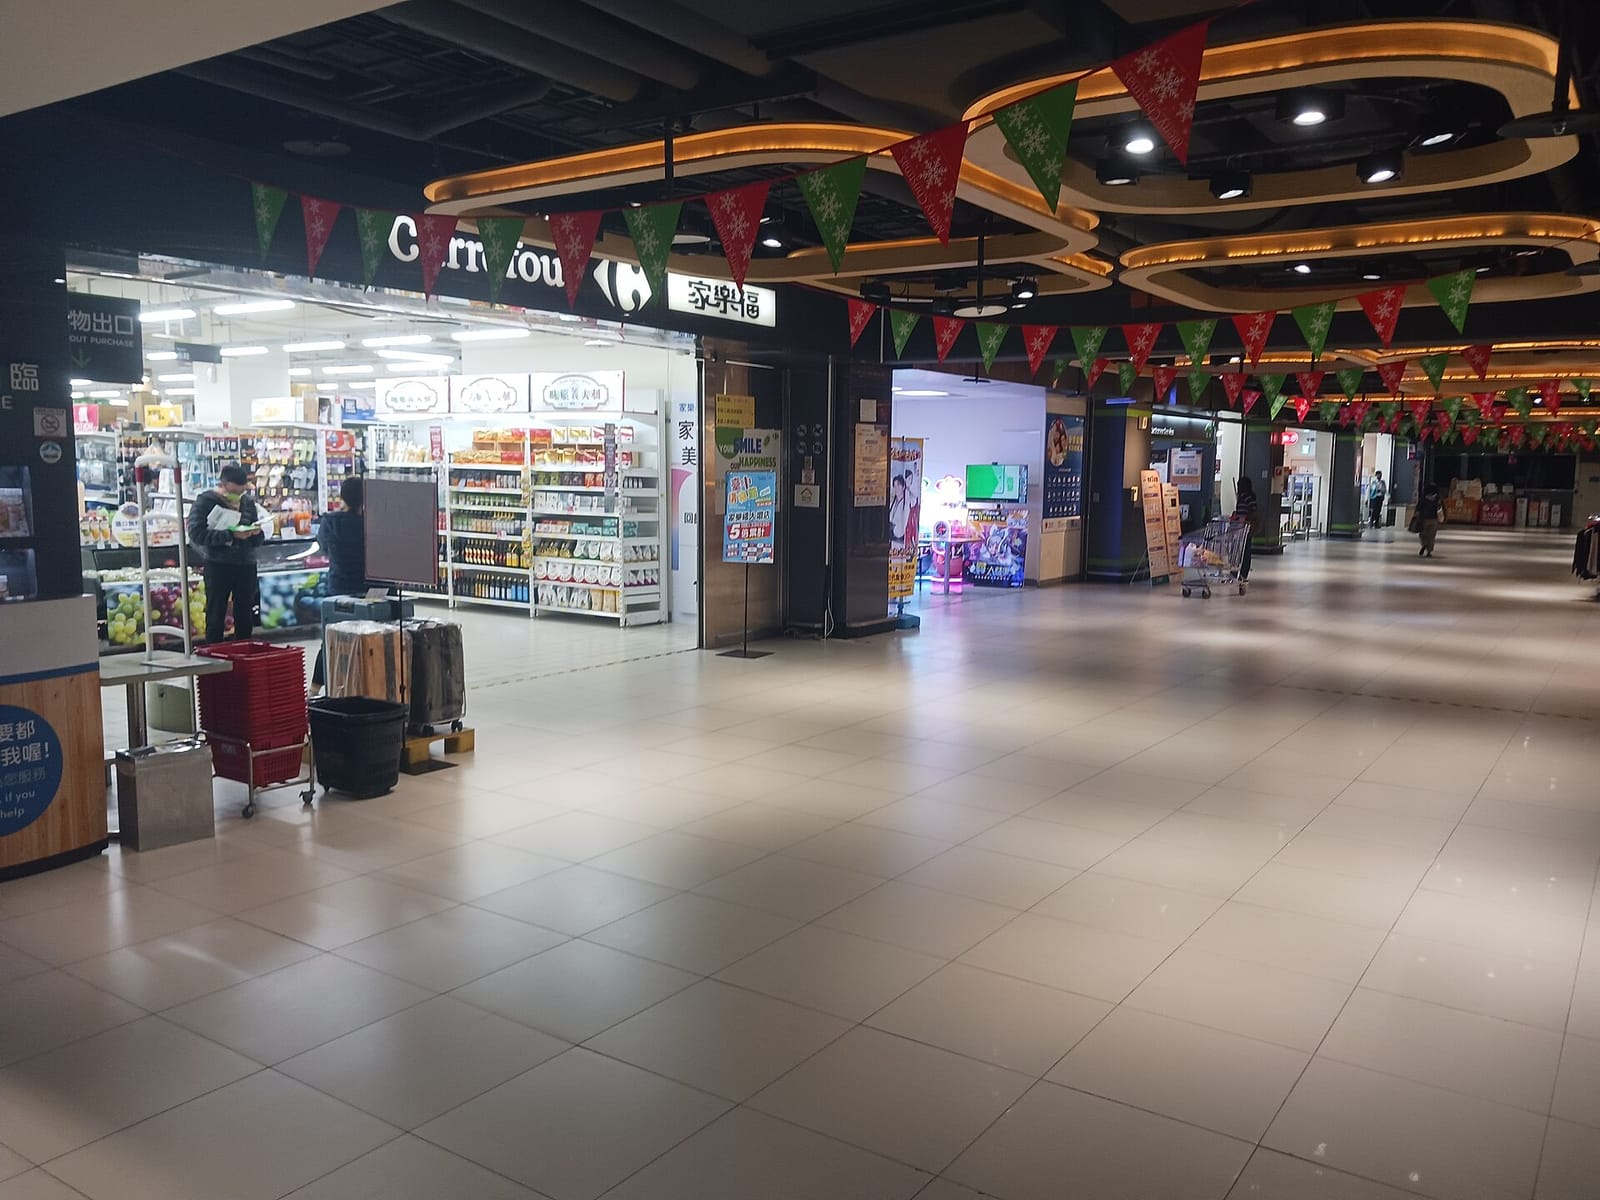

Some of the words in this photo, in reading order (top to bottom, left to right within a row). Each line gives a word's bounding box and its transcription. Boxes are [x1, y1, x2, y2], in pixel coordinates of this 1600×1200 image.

[688, 280, 760, 320] 家樂福
[90, 337, 134, 348] PURCHASE
[9, 362, 40, 392] 臨
[678, 420, 694, 440] 家
[734, 437, 762, 454] SMILE
[739, 457, 777, 468] HAPPINESS
[15, 789, 36, 804] you
